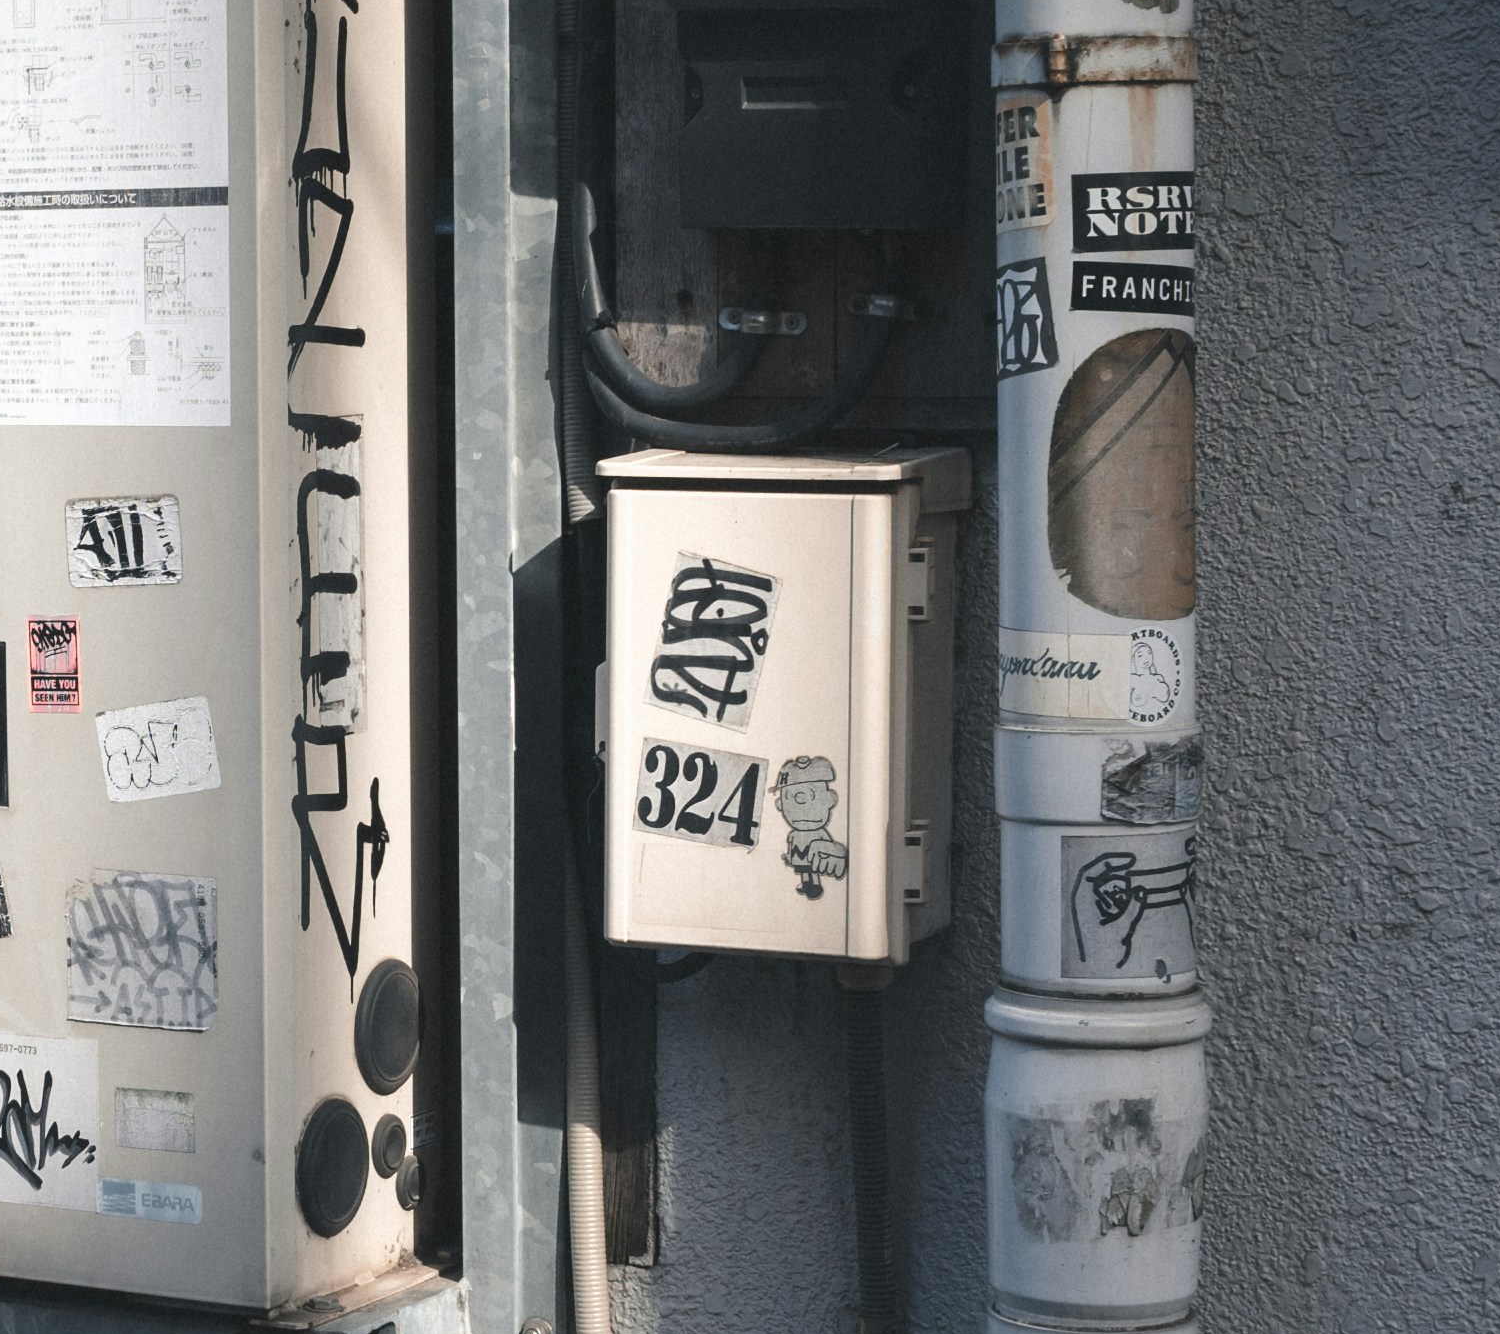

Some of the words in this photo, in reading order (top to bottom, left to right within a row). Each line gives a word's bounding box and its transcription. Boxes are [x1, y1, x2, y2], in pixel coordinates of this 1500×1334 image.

[1082, 275, 1194, 304] FRANCHI
[1130, 628, 1181, 667] RTBOARDS
[34, 678, 57, 691] HAVE
[58, 678, 77, 691] YOU
[34, 691, 55, 704] SEEN
[637, 744, 760, 846] 324
[141, 1192, 196, 1212] EBARA
